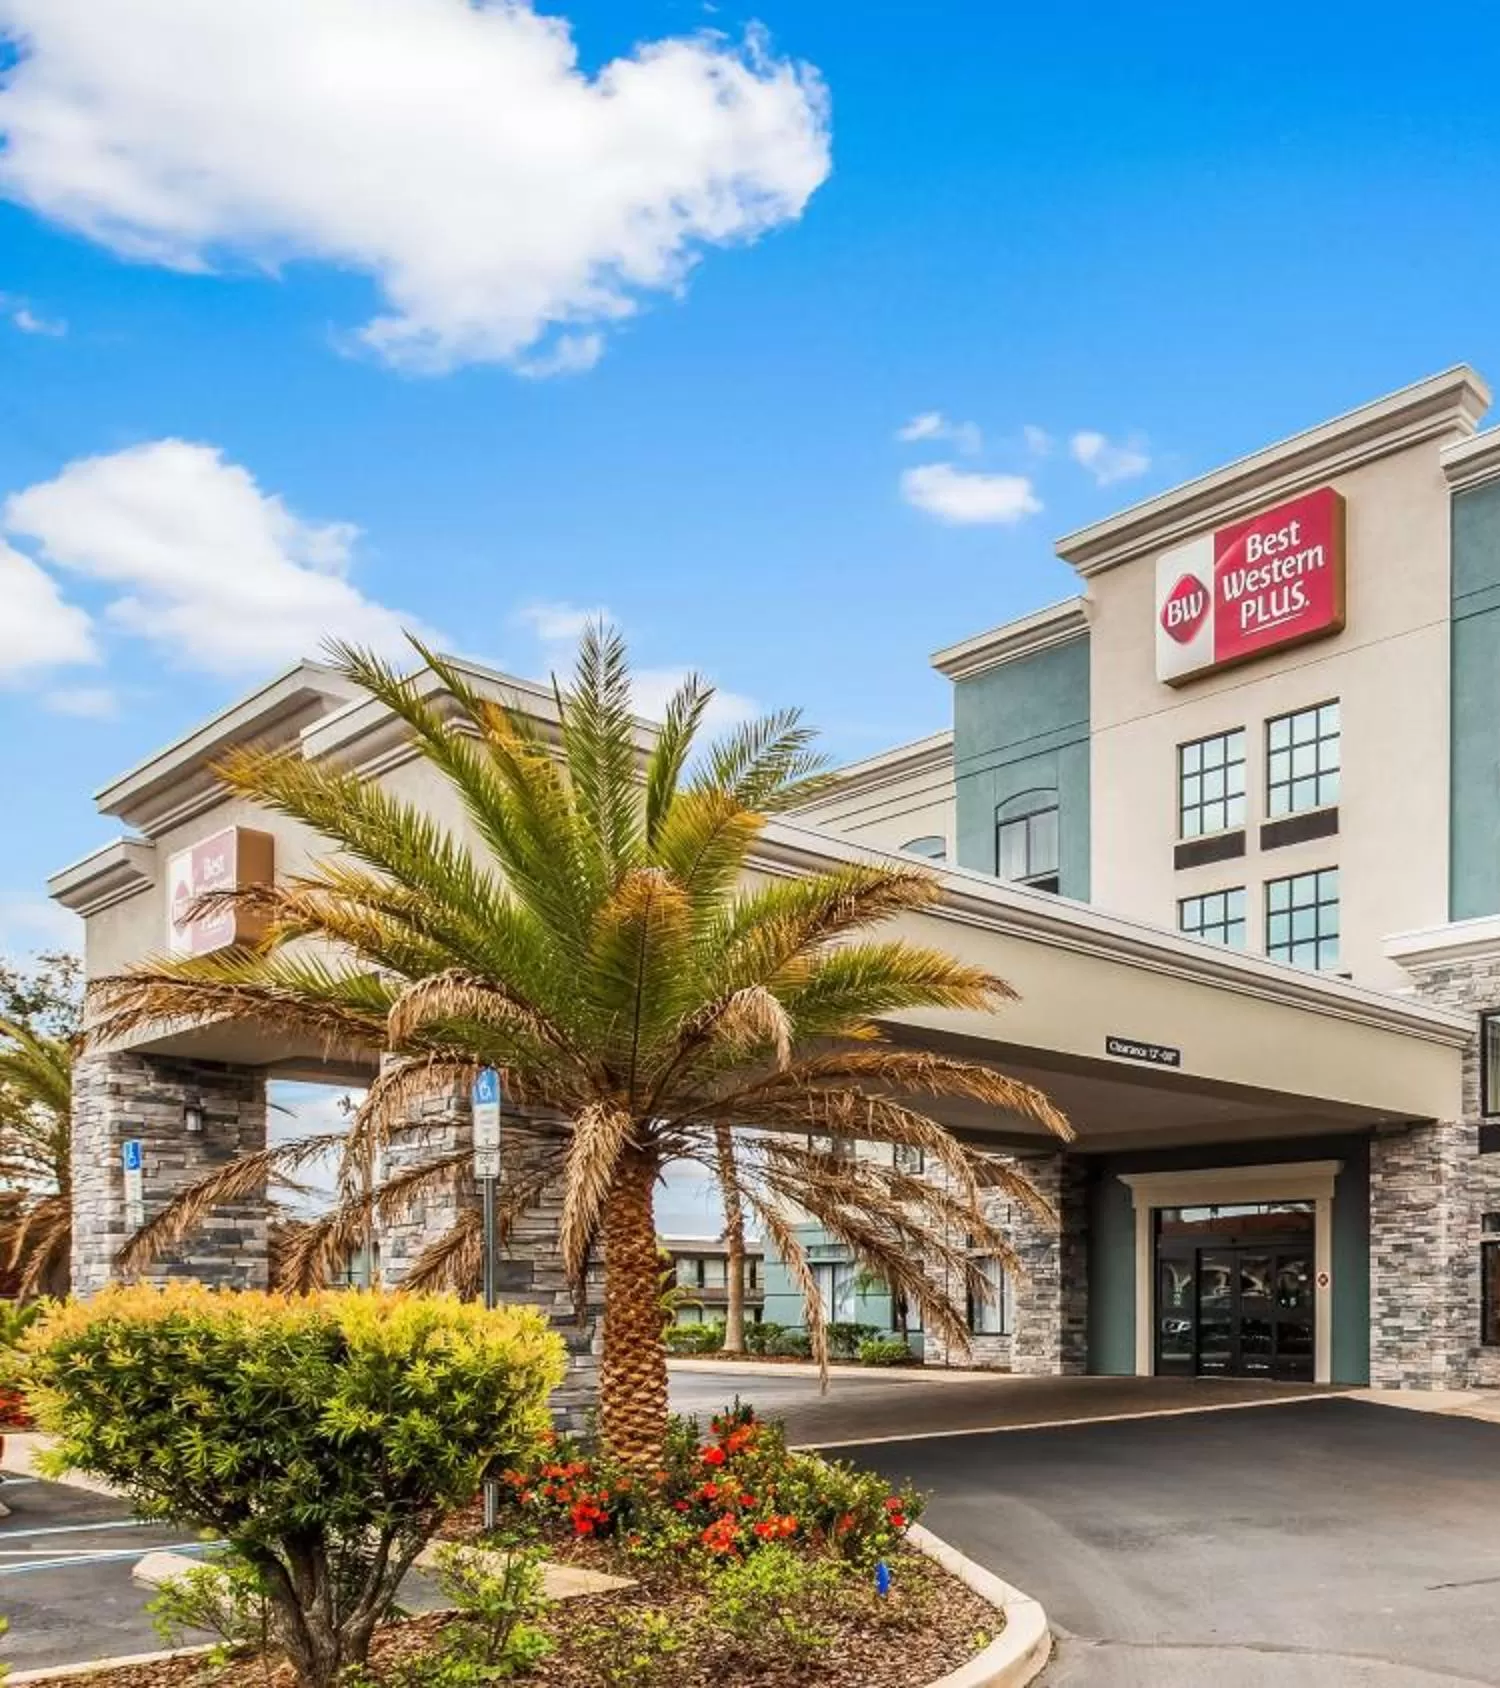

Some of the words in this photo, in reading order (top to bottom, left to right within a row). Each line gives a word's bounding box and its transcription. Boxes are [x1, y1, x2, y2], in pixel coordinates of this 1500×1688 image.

[1246, 520, 1301, 563] Best
[1222, 544, 1324, 602] Western
[1167, 591, 1203, 627] BW
